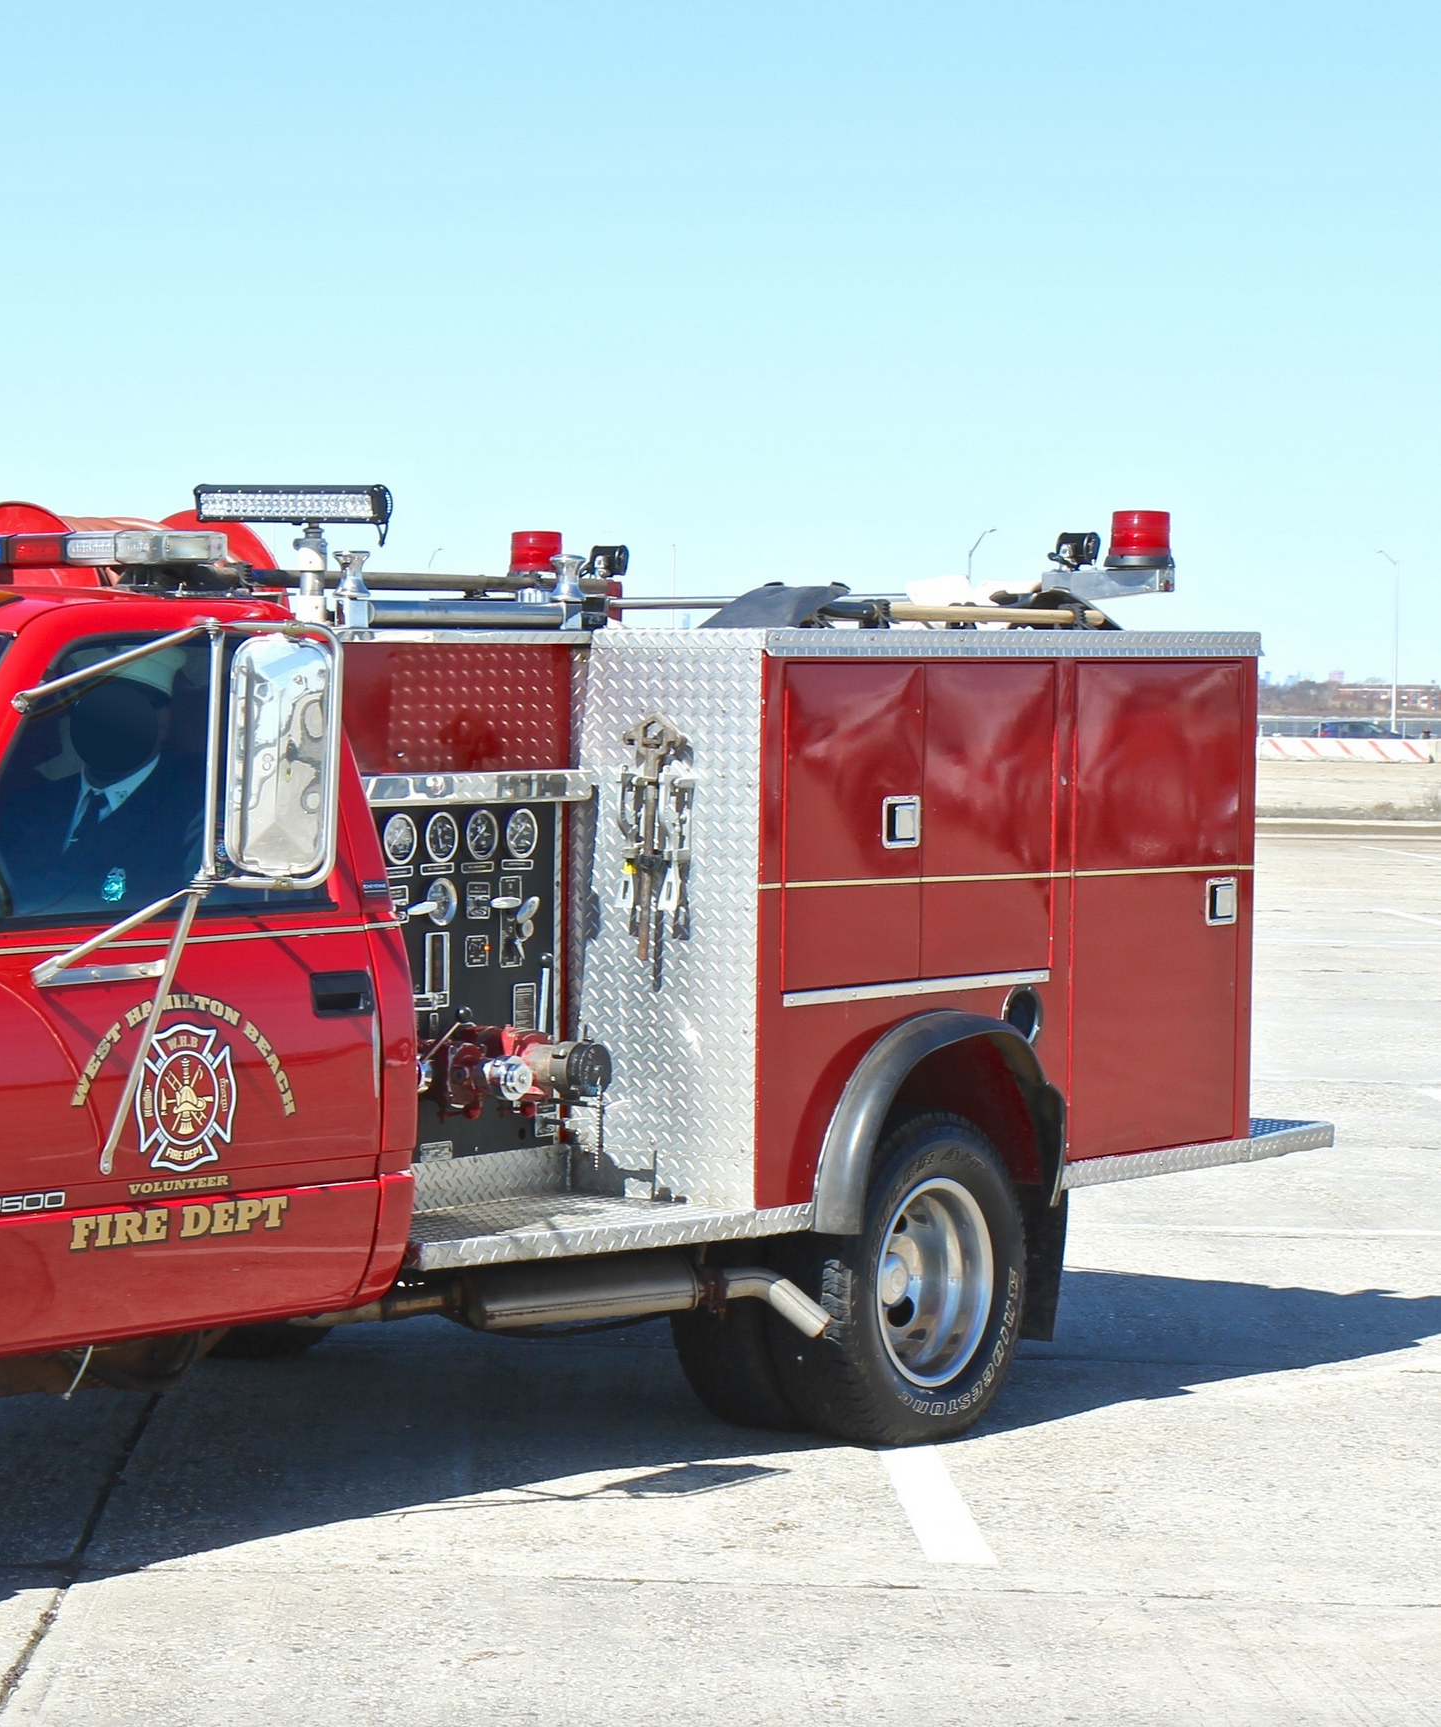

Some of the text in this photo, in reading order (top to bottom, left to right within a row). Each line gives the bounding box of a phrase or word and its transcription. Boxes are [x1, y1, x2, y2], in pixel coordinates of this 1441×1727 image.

[70, 993, 297, 1117] WEST HAMILTON BEACH
[165, 1144, 204, 1160] FIRE DEPT
[128, 1175, 229, 1195] VOLUNTEER
[69, 1195, 288, 1250] FIRE DEPT
[898, 1265, 1019, 1417] BRIDGESTONE
